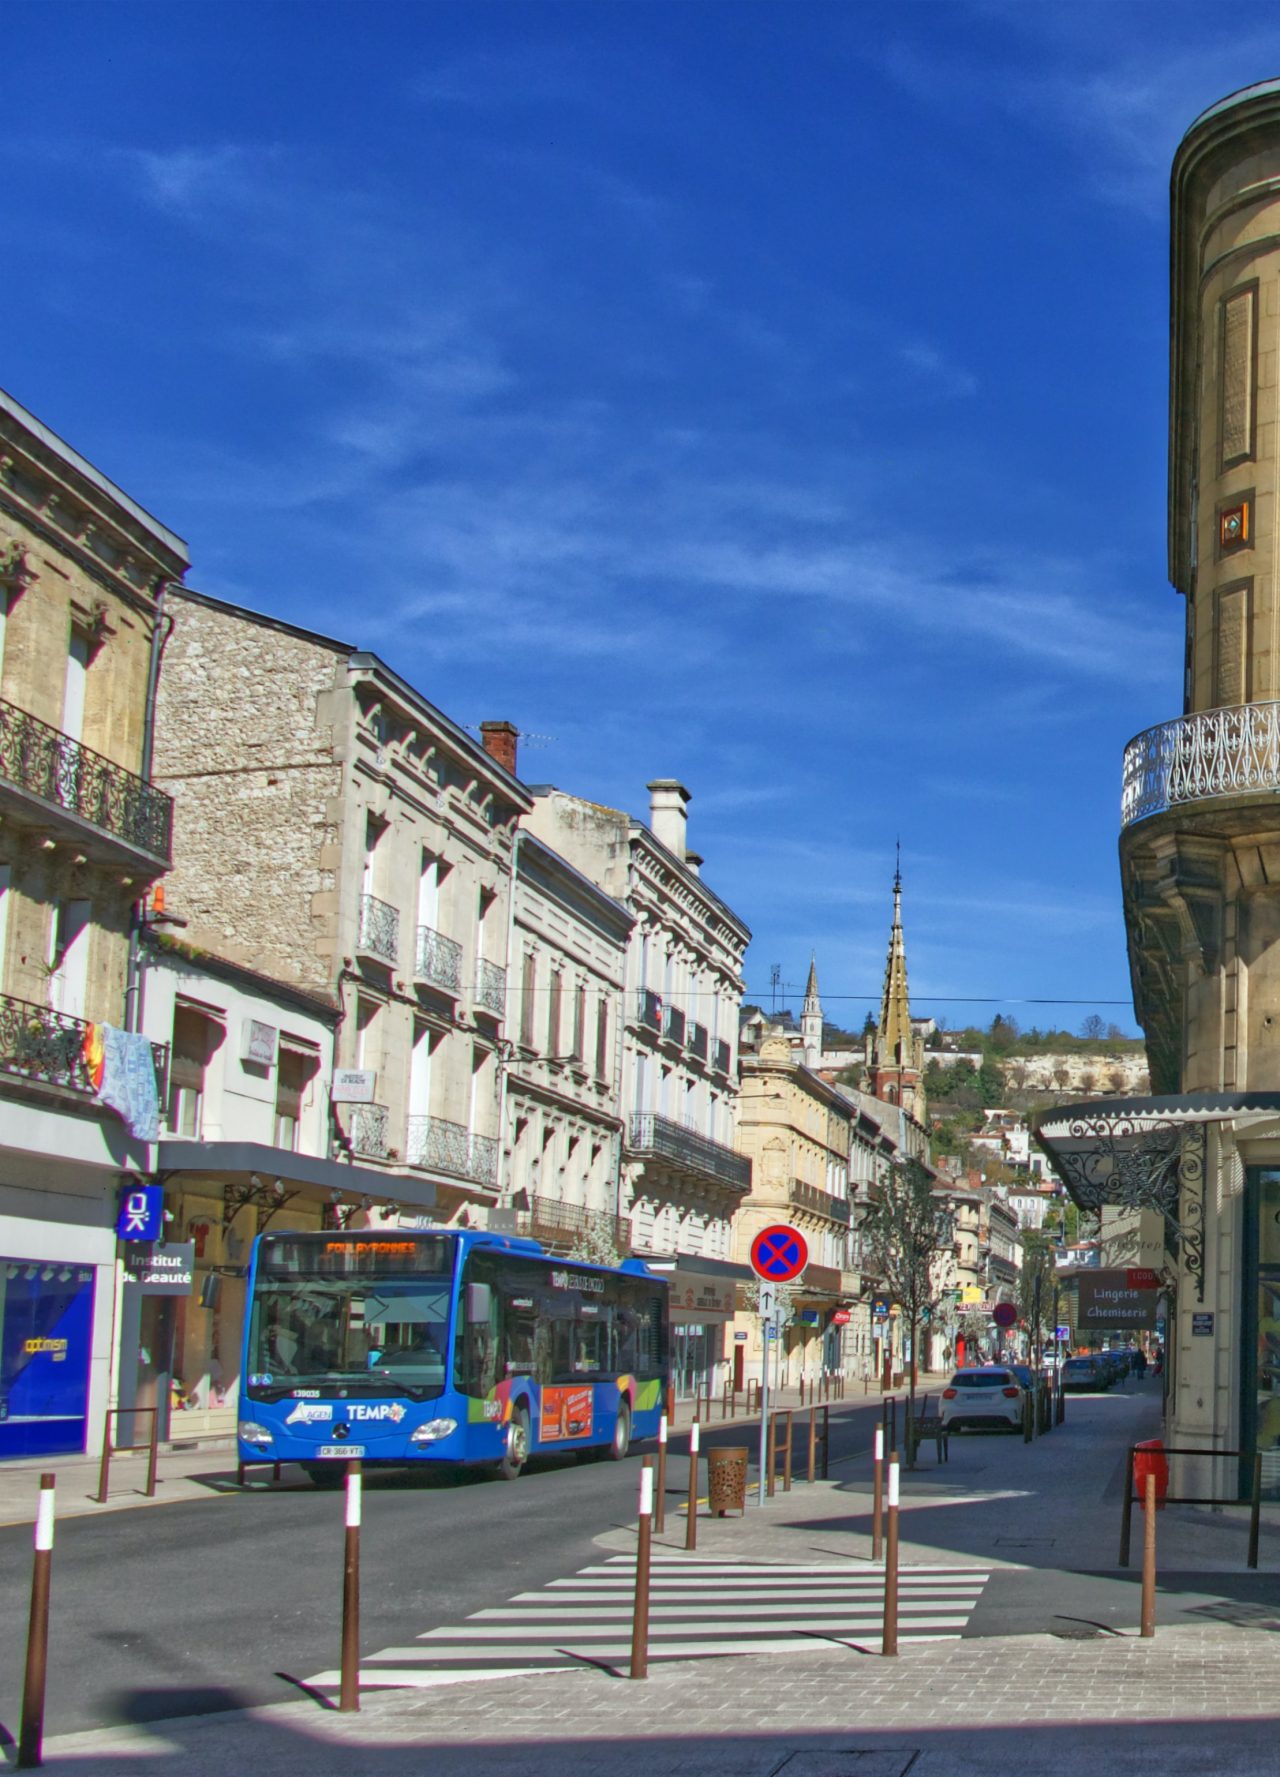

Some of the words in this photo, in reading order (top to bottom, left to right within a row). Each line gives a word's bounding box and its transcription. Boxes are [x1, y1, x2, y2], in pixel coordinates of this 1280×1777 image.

[131, 1254, 182, 1267] Institut
[141, 1271, 192, 1283] Beauté
[1094, 1288, 1139, 1303] Lingerie
[1087, 1306, 1148, 1318] Chemiserie
[307, 1411, 332, 1419] AGEN
